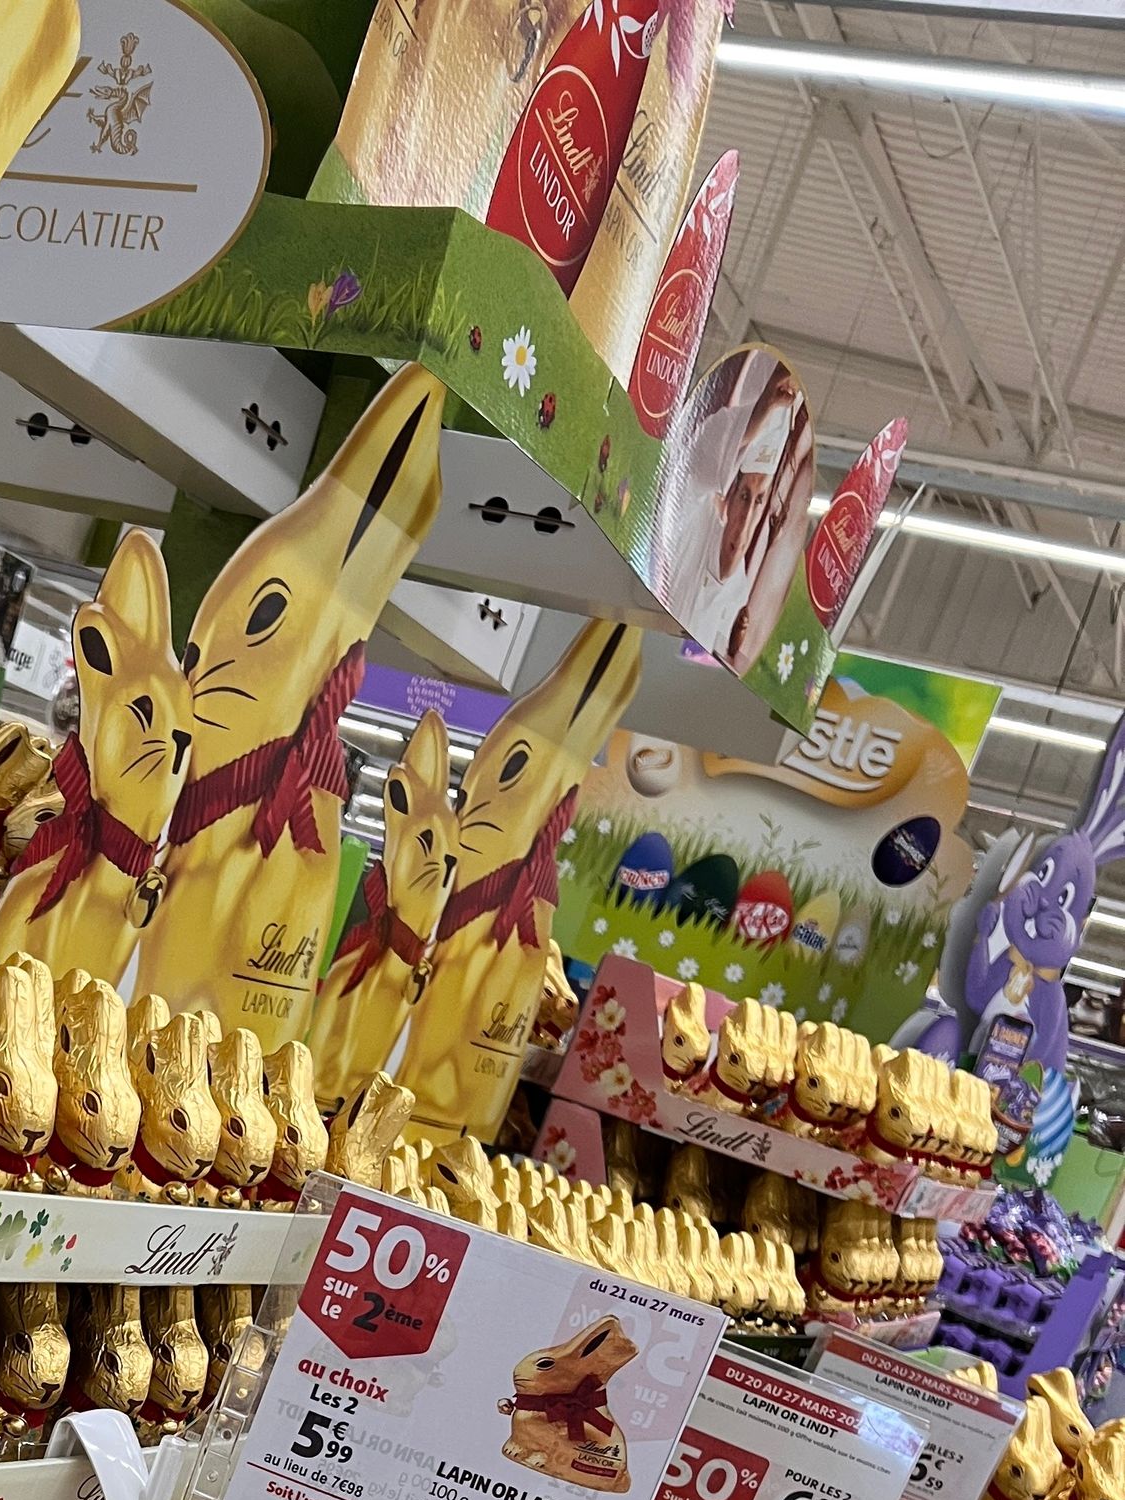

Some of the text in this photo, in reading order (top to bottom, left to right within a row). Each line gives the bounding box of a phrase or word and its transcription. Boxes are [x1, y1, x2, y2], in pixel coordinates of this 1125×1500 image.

[547, 91, 594, 175] Lindt
[530, 140, 576, 241] LINDOR
[657, 293, 694, 337] Lindt
[247, 923, 310, 976] Lindt
[242, 991, 293, 1018] LAPIN OR
[675, 1111, 757, 1152] Lindt
[125, 1225, 217, 1276] Lindt
[325, 1206, 450, 1290] 50%
[323, 1276, 358, 1299] sur
[589, 1279, 706, 1327] du 21 au 27 mars
[320, 1291, 423, 1333] le 2ème
[298, 1358, 389, 1403] au choix
[862, 1352, 878, 1363] DU
[879, 1358, 892, 1370] 20
[892, 1364, 908, 1377] AU
[909, 1371, 922, 1382] 27
[923, 1376, 951, 1394] MARS
[876, 1374, 954, 1410] LAPIN OR LINDT
[309, 1383, 359, 1415] Les 2
[725, 1367, 865, 1429] DU 20 AU 27 MARS 202
[742, 1393, 838, 1438] LAPIN OR LINDT
[264, 1452, 364, 1498] au lieu de 7€98
[266, 1480, 294, 1500] Soit
[436, 1461, 492, 1494] LAPIN
[785, 1469, 819, 1490] POUR
[819, 1482, 841, 1498] LES
